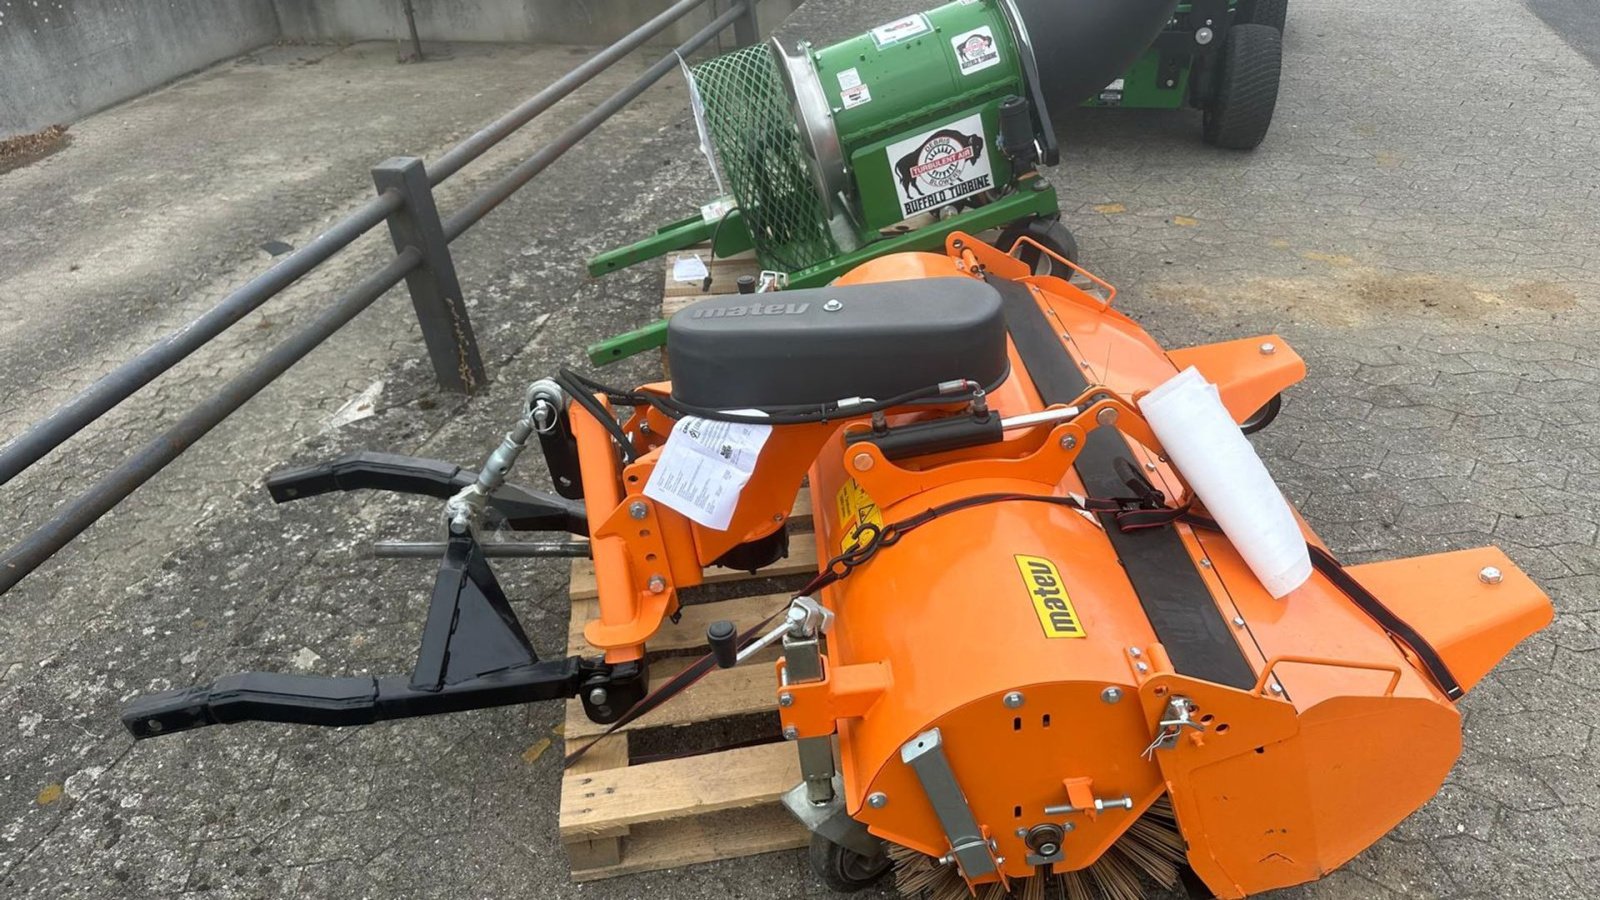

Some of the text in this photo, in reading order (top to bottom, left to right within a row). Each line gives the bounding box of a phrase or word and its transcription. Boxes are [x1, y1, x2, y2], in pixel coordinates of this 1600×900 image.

[924, 138, 951, 153] DEBRIS
[912, 148, 973, 177] TURBULENT AIR
[928, 169, 962, 187] BLOWERS
[903, 173, 991, 215] BUFFALO TURBINE
[691, 302, 811, 319] matev
[1027, 560, 1078, 632] matev
